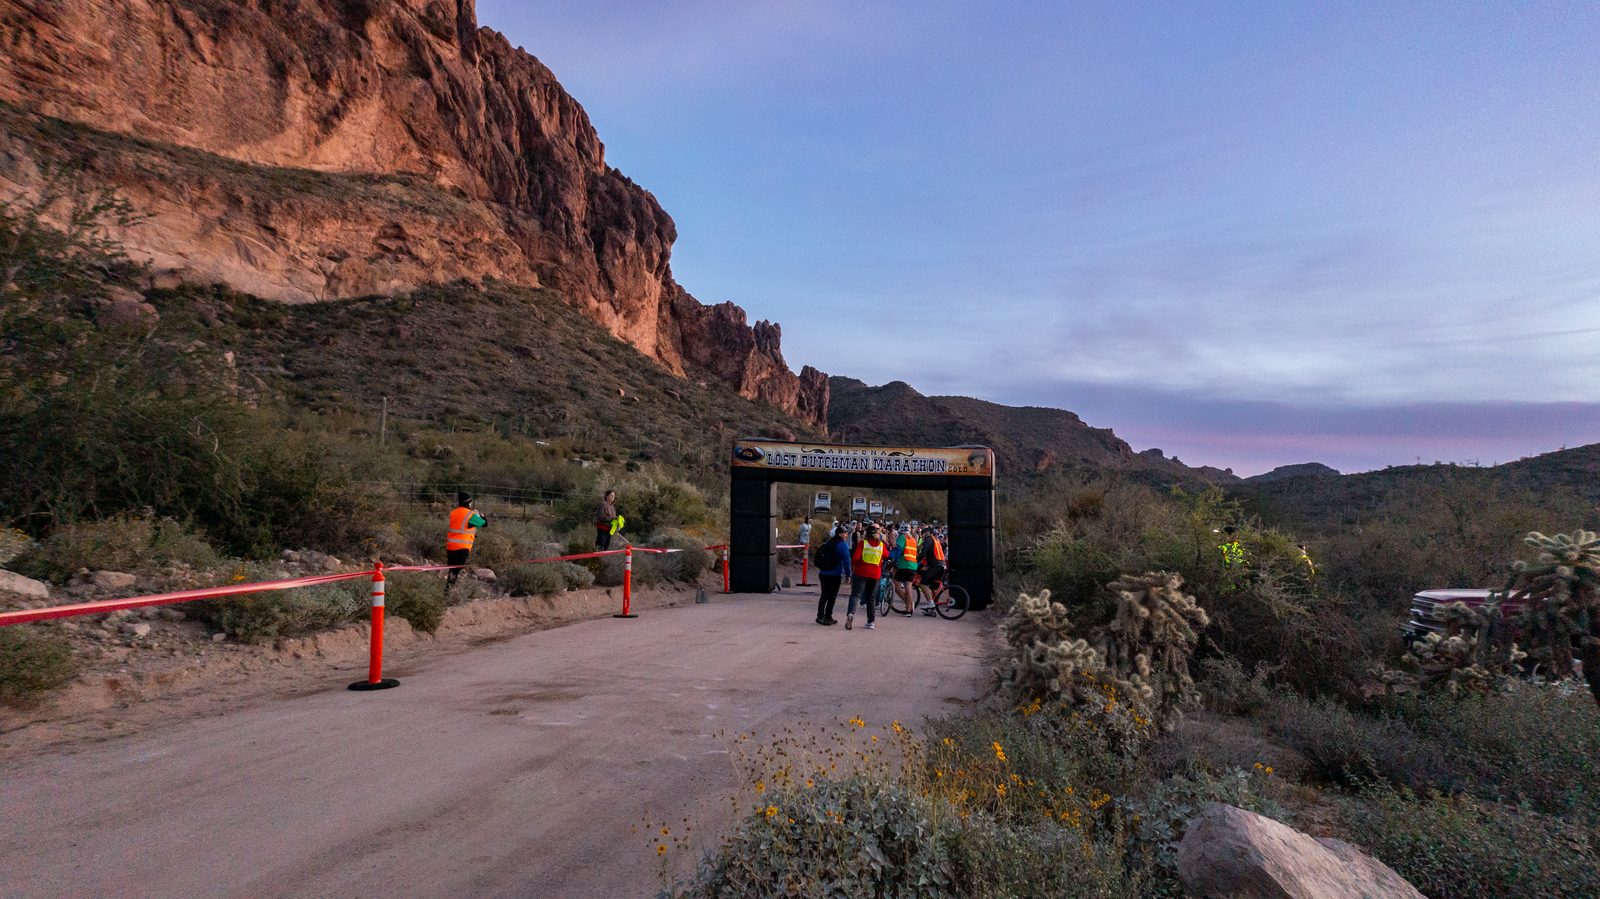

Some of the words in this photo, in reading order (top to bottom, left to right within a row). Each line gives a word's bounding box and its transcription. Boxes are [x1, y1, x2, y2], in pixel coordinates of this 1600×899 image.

[767, 453, 797, 467] LOST
[801, 455, 869, 470] DUTCHMAN
[873, 457, 946, 473] MARATHON
